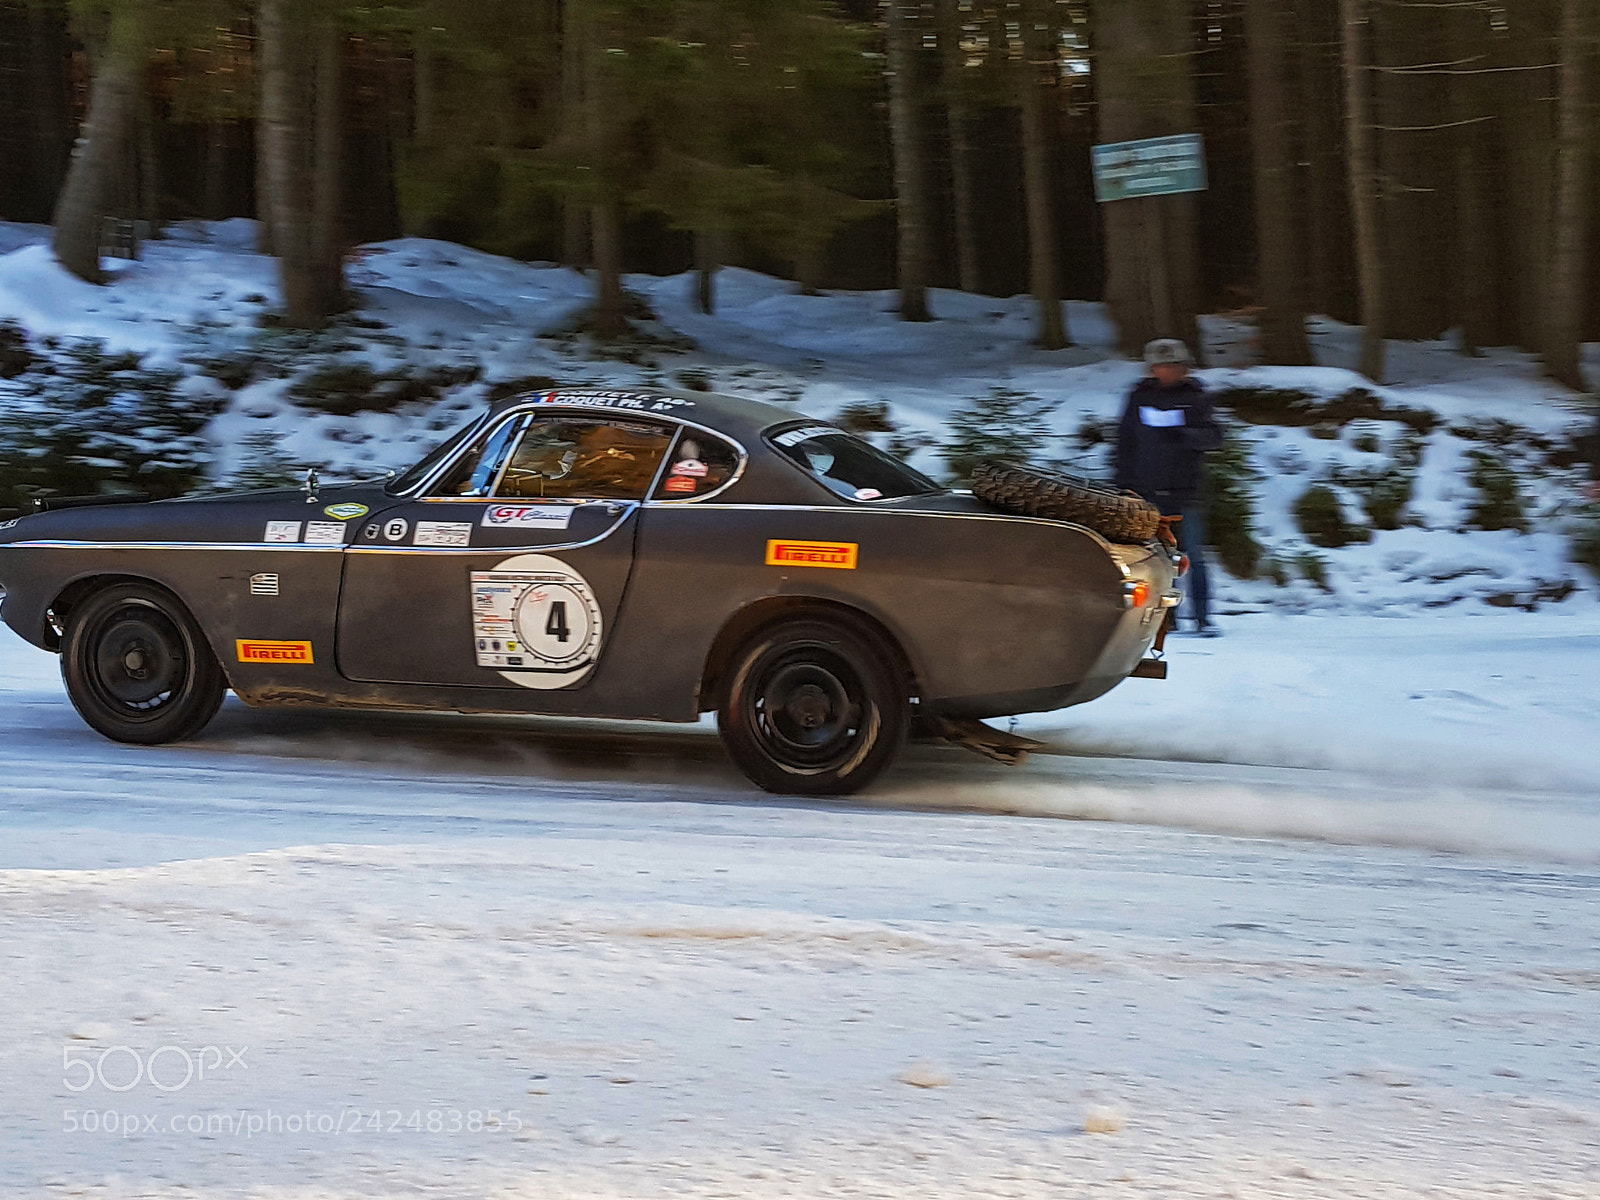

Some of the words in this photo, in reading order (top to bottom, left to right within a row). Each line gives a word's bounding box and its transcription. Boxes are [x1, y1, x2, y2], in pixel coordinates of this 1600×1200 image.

[553, 395, 618, 406] COQUET
[389, 523, 403, 536] B
[774, 544, 850, 564] PIRELLI
[545, 601, 572, 642] 4
[242, 644, 307, 660] PIRELLI
